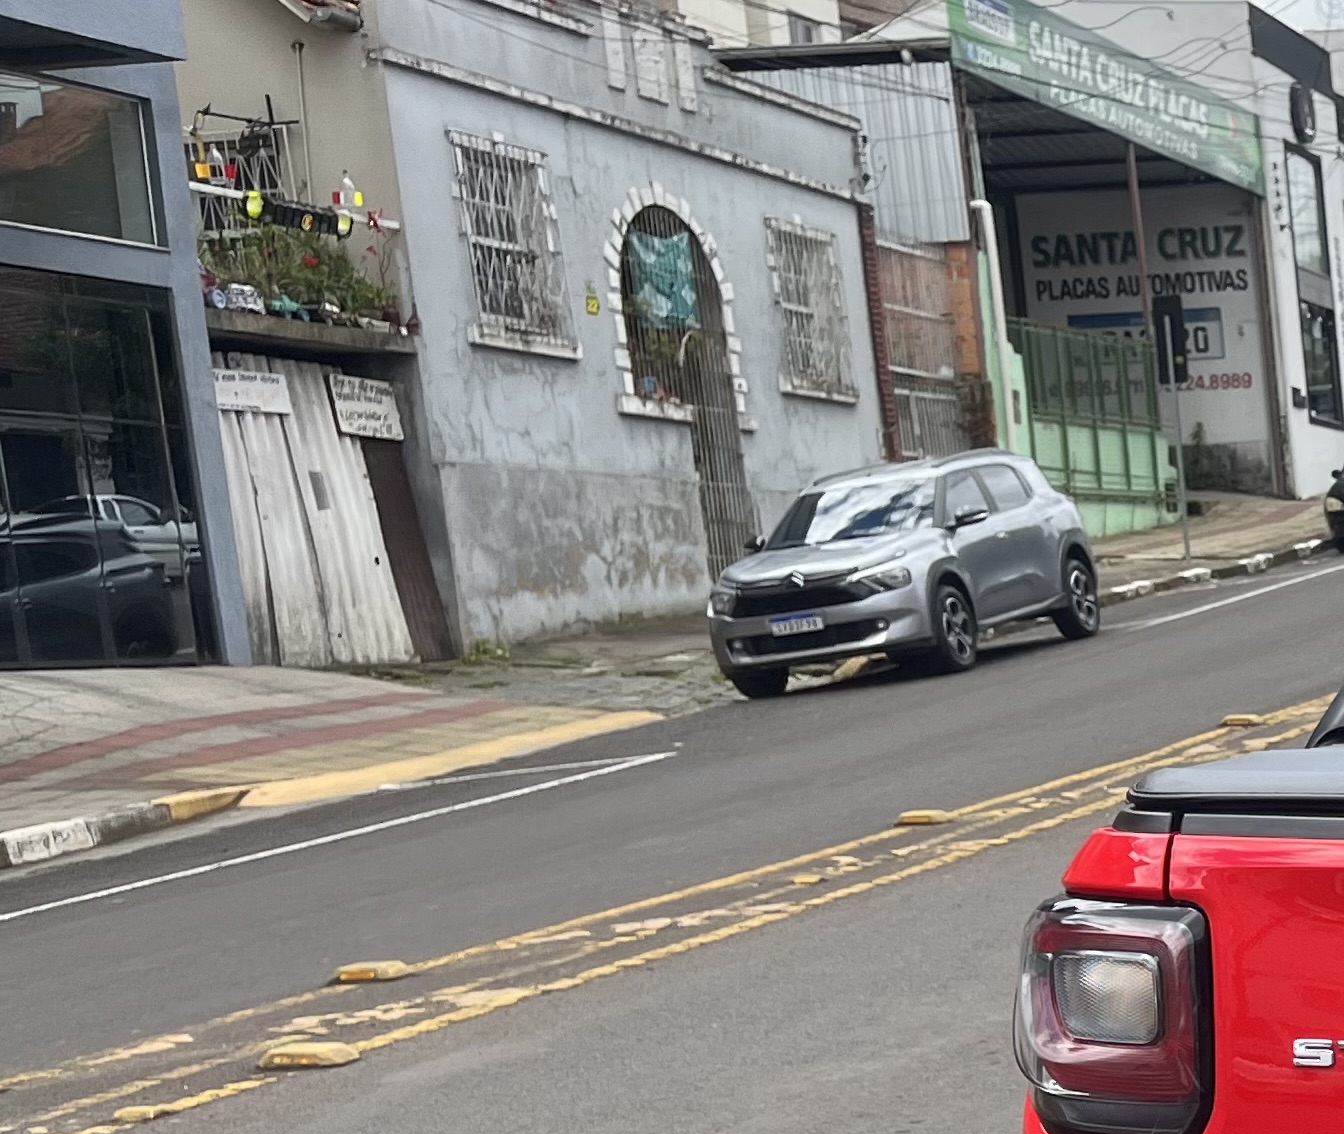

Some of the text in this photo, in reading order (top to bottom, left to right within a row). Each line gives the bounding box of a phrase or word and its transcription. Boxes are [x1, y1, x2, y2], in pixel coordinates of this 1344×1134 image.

[1028, 21, 1209, 138] SANTA CRUZ PLACAS
[1050, 80, 1198, 159] PLACAS AUTOMOTIVAS
[1031, 224, 1246, 268] SANTA CRUZ
[1036, 269, 1249, 302] PLACAS AUOMOTIVAS
